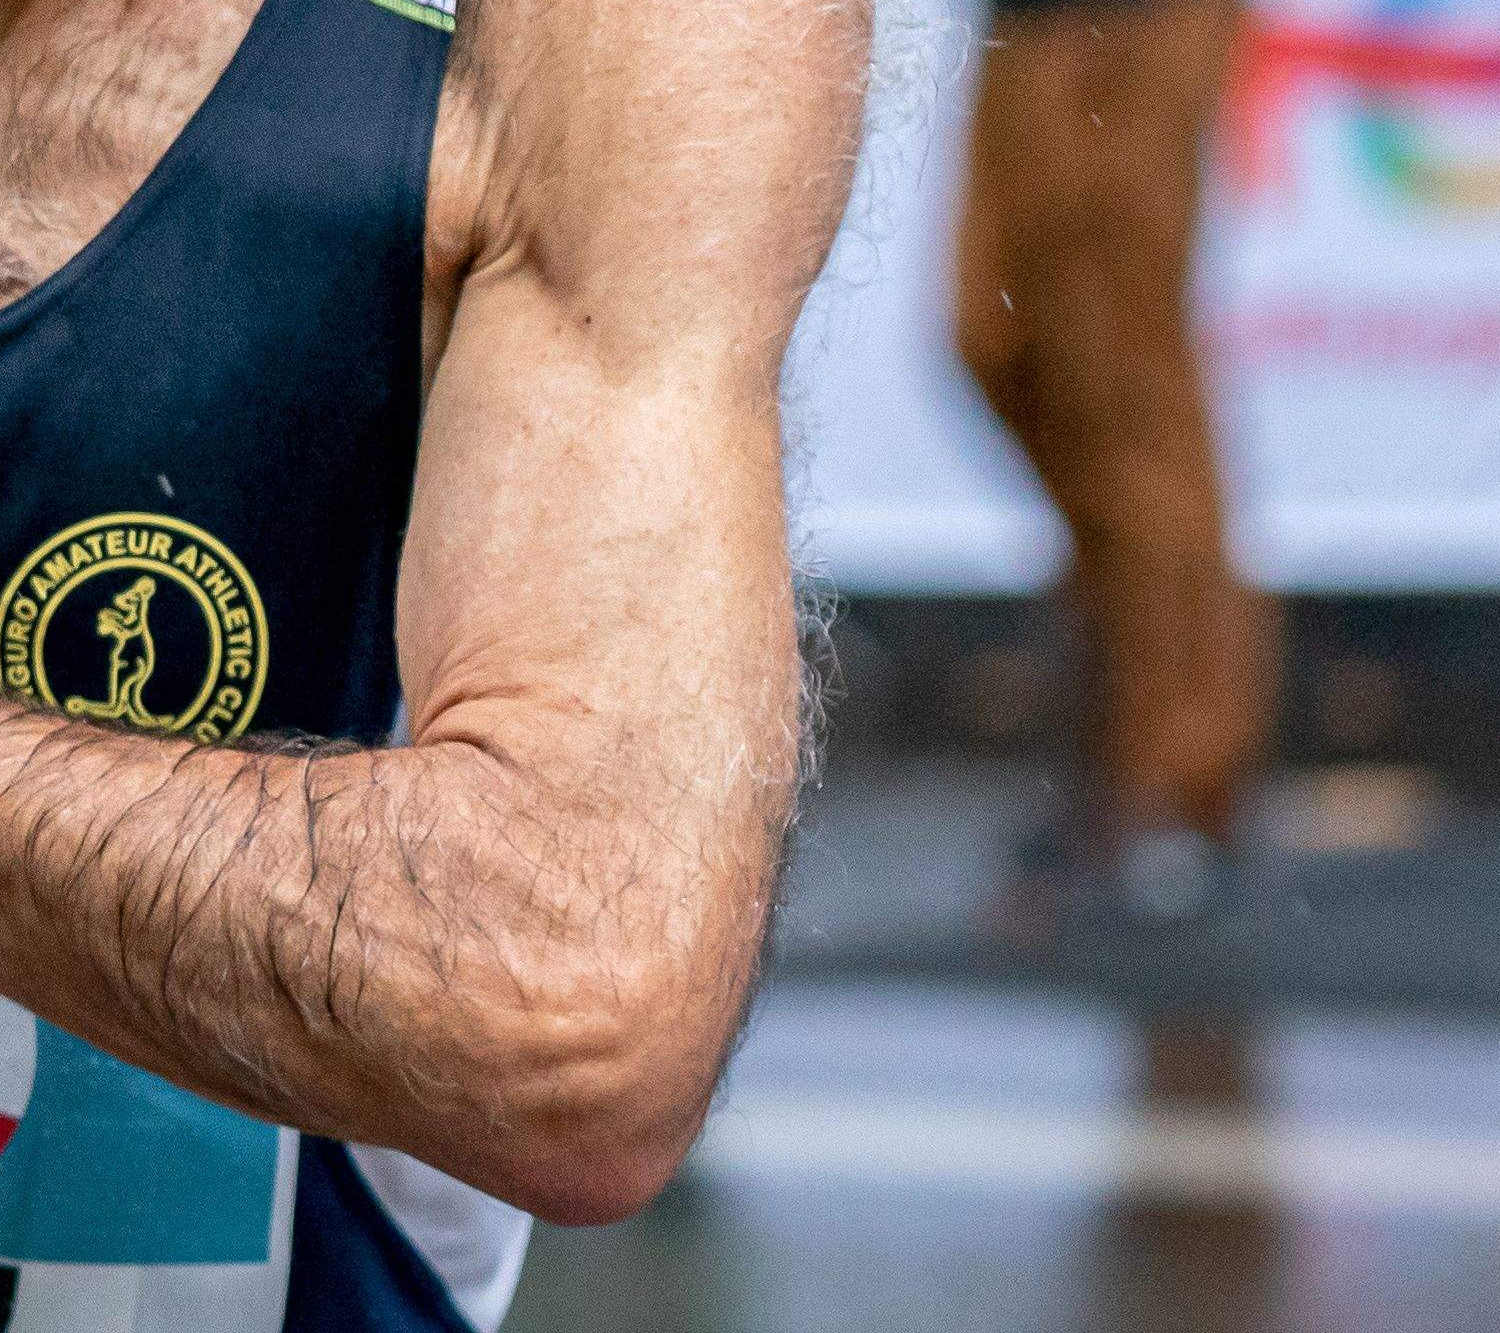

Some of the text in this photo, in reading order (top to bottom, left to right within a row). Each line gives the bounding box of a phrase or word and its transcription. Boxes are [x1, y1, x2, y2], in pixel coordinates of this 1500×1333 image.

[4, 529, 253, 745] GURO AMATEUR ATHLETIC CLU
